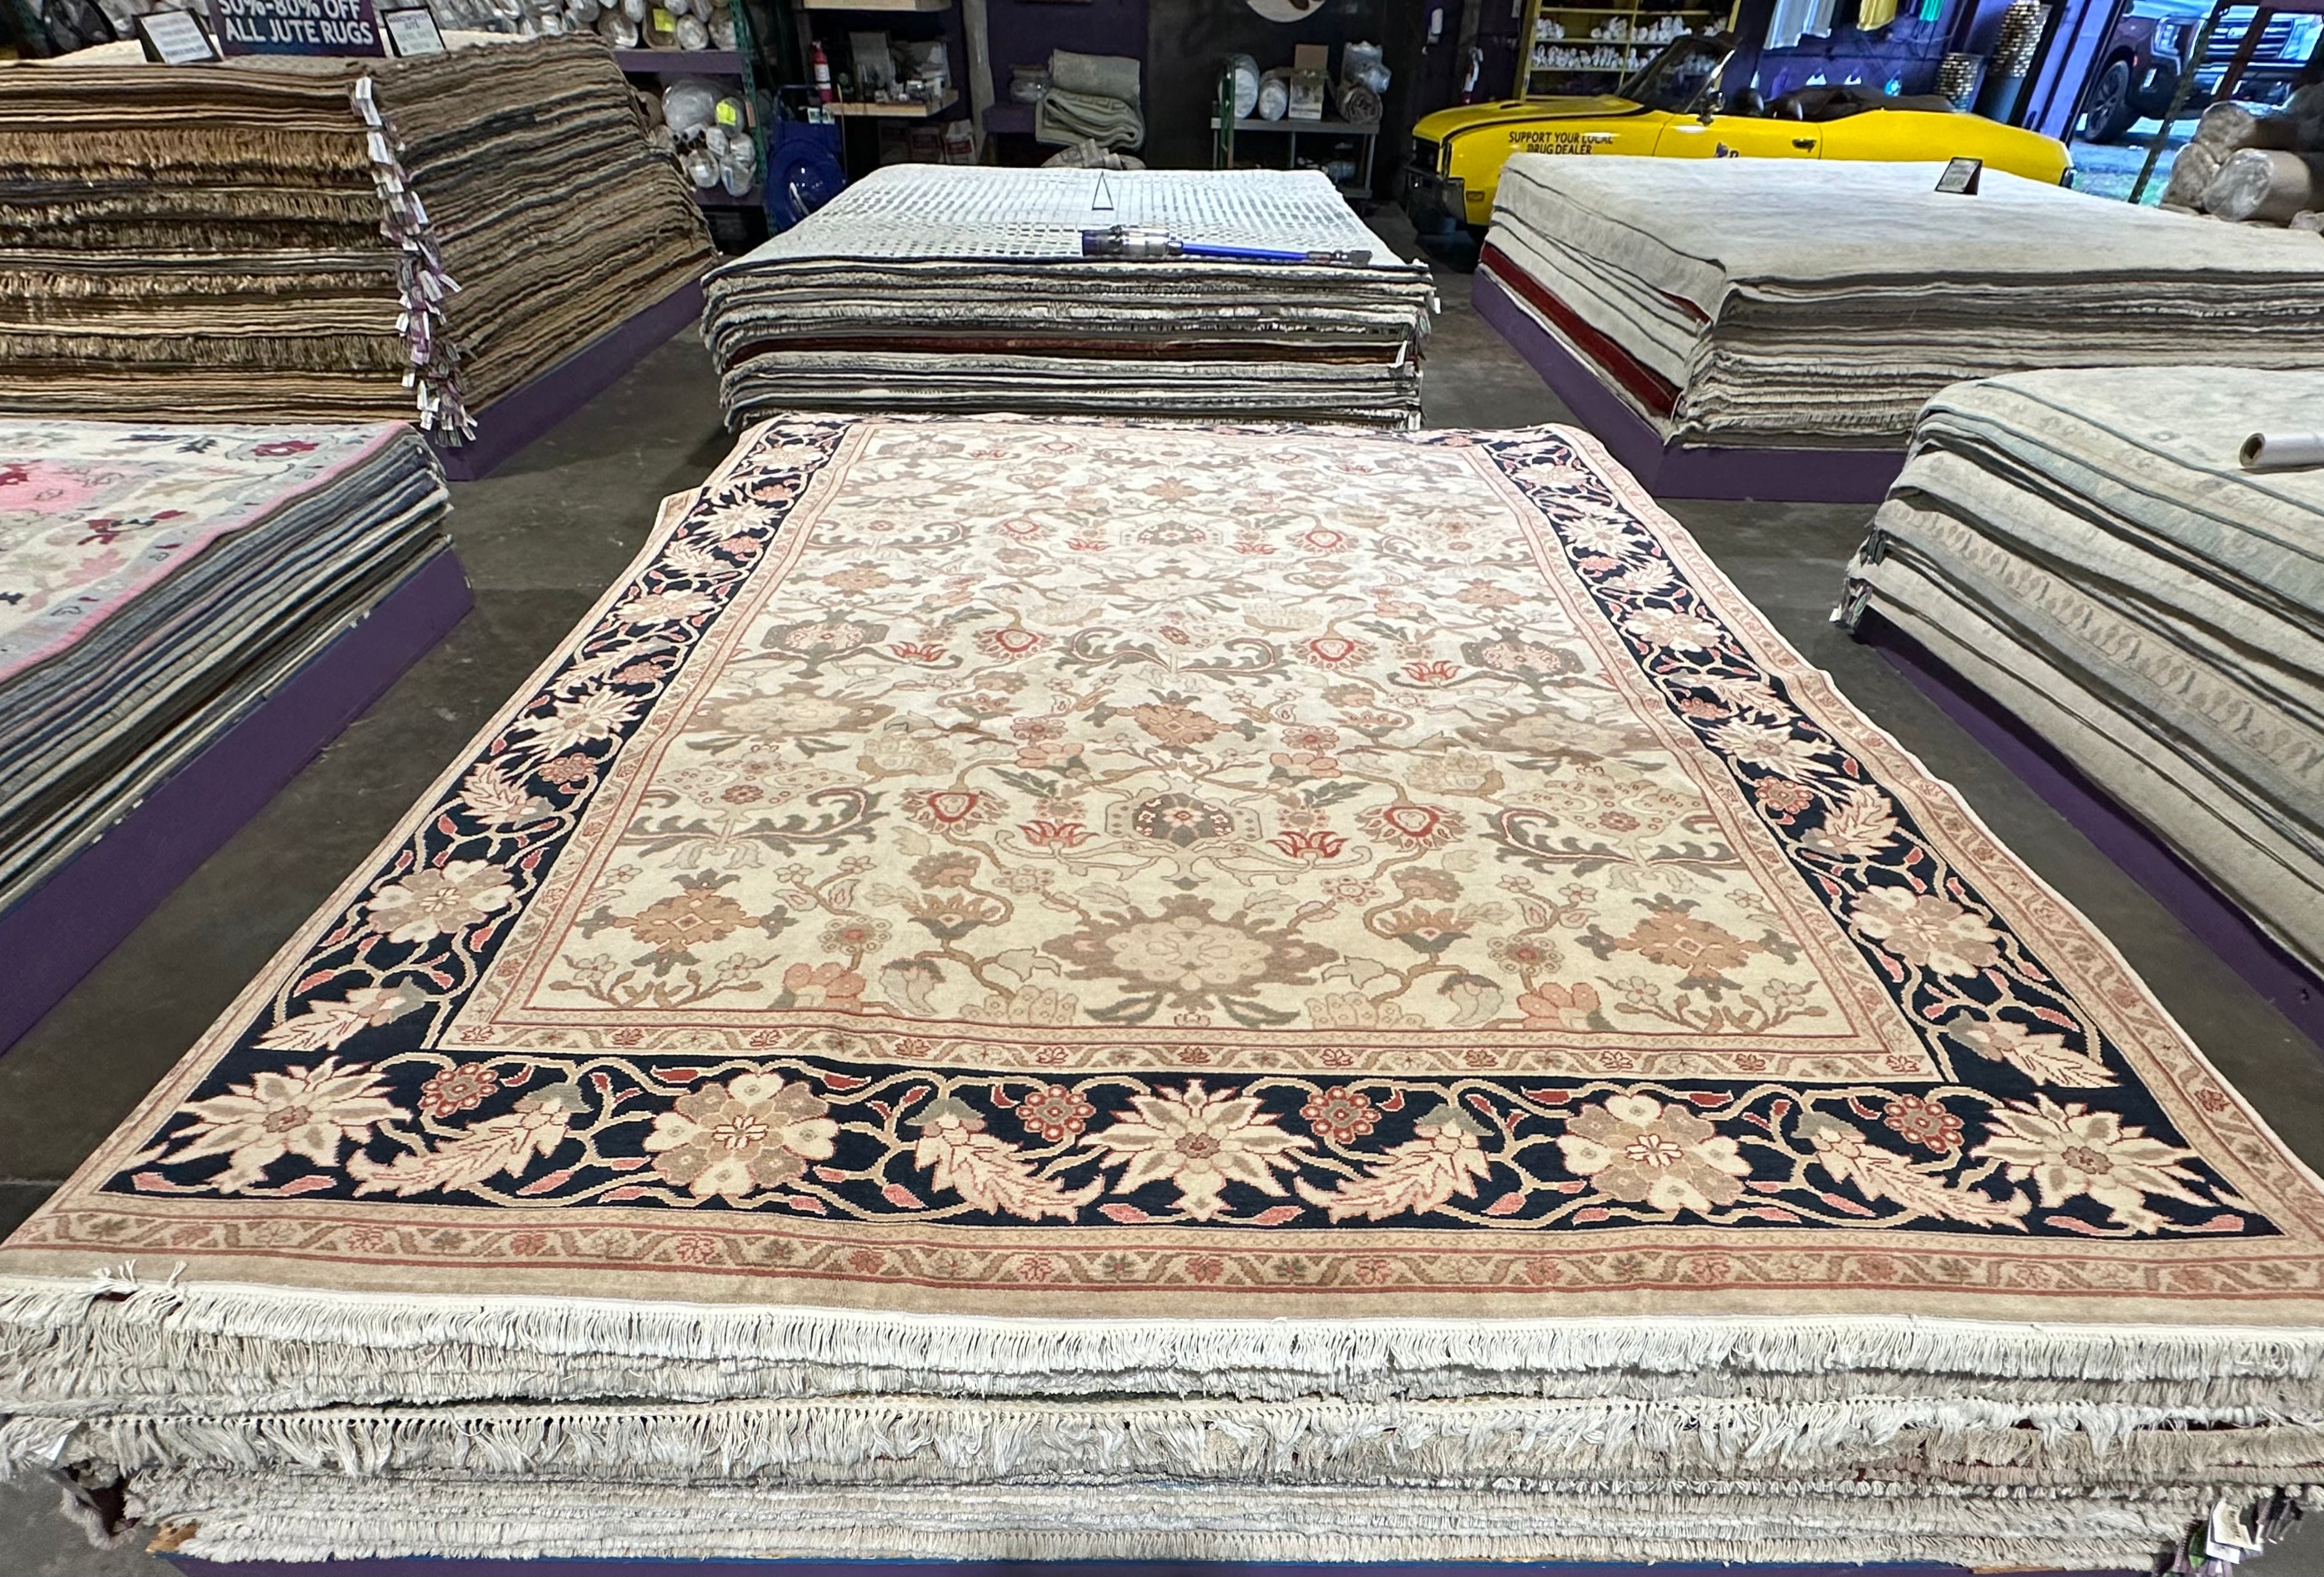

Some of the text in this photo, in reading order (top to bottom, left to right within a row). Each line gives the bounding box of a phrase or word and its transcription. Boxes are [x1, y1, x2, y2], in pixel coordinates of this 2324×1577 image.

[325, 0, 360, 19] OFF
[225, 17, 266, 42] ALL
[269, 18, 320, 43] JUTE
[320, 20, 374, 45] RUGS
[1509, 131, 1613, 145] SUPPORT YOUR LOCAL
[1527, 143, 1592, 155] DRUG DEALER
